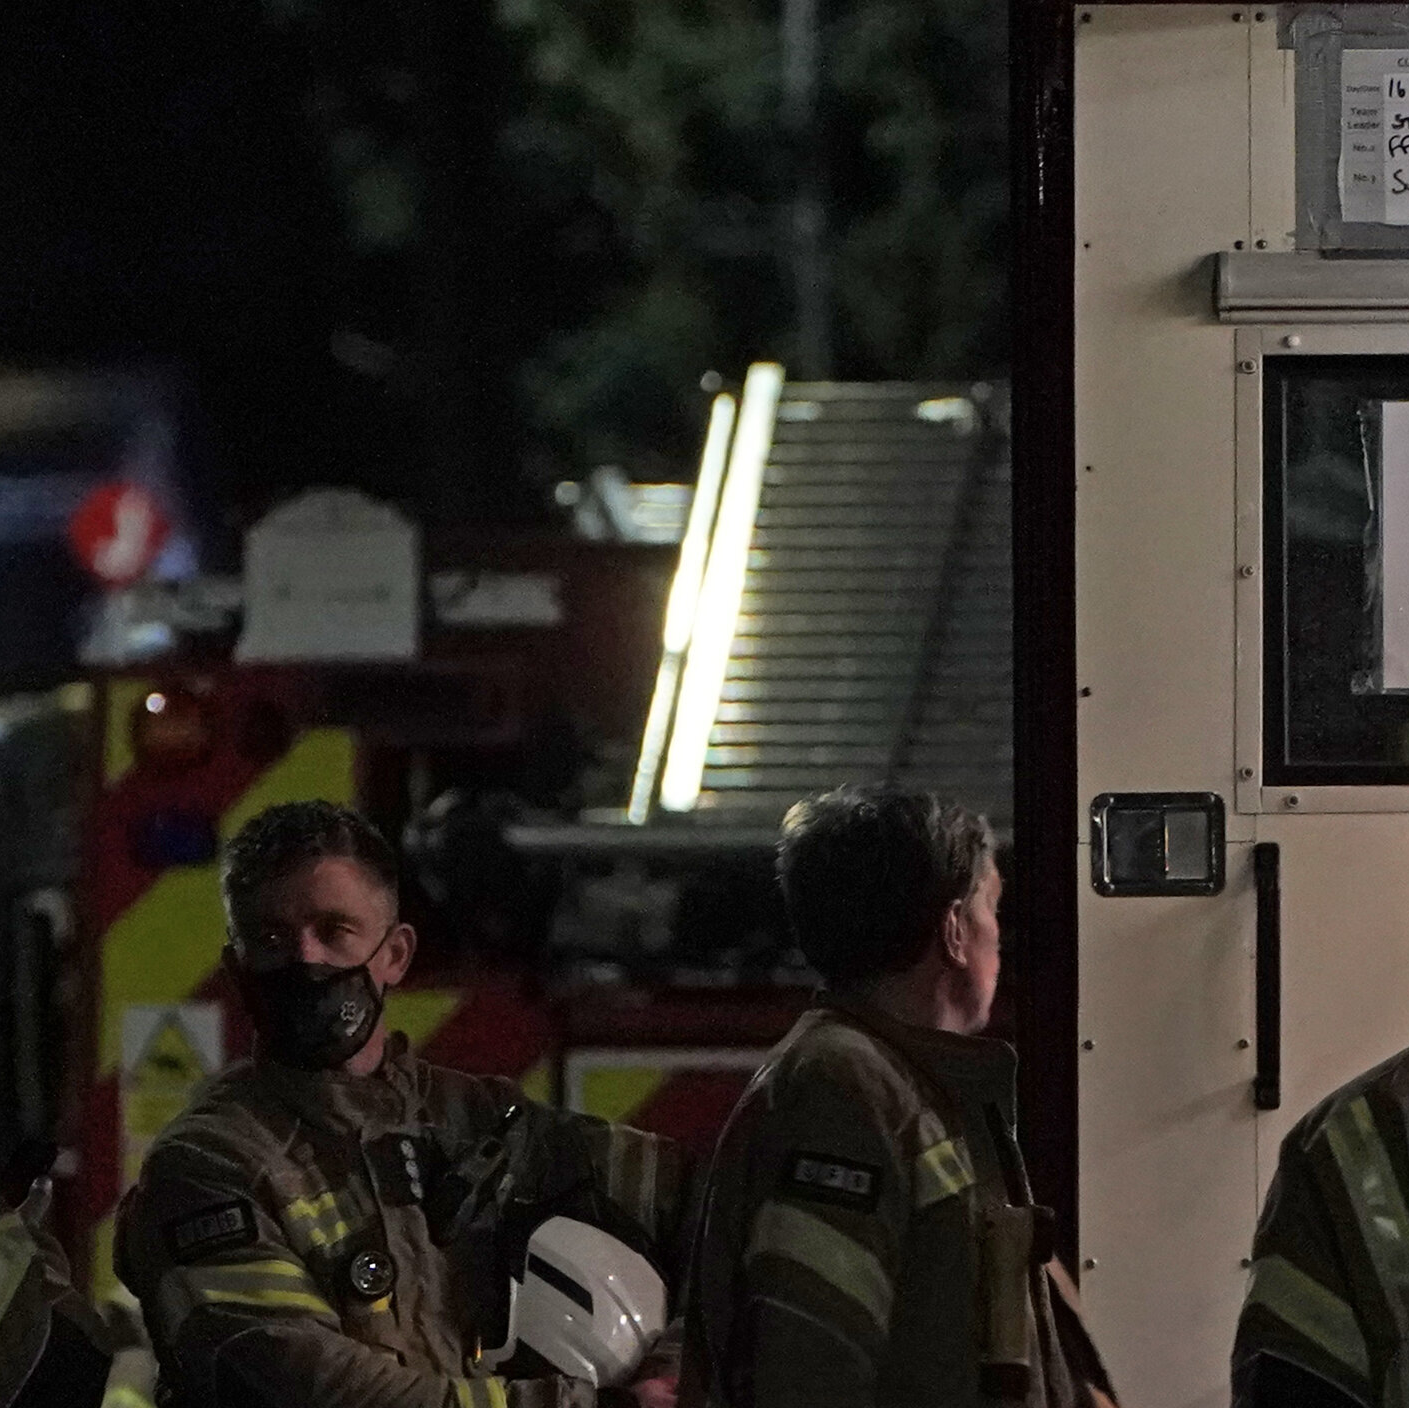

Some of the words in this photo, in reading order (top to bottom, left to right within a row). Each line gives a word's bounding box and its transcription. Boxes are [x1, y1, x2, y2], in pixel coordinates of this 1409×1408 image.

[1388, 77, 1406, 98] 16
[1350, 106, 1379, 116] Team
[1346, 121, 1380, 130] Leader
